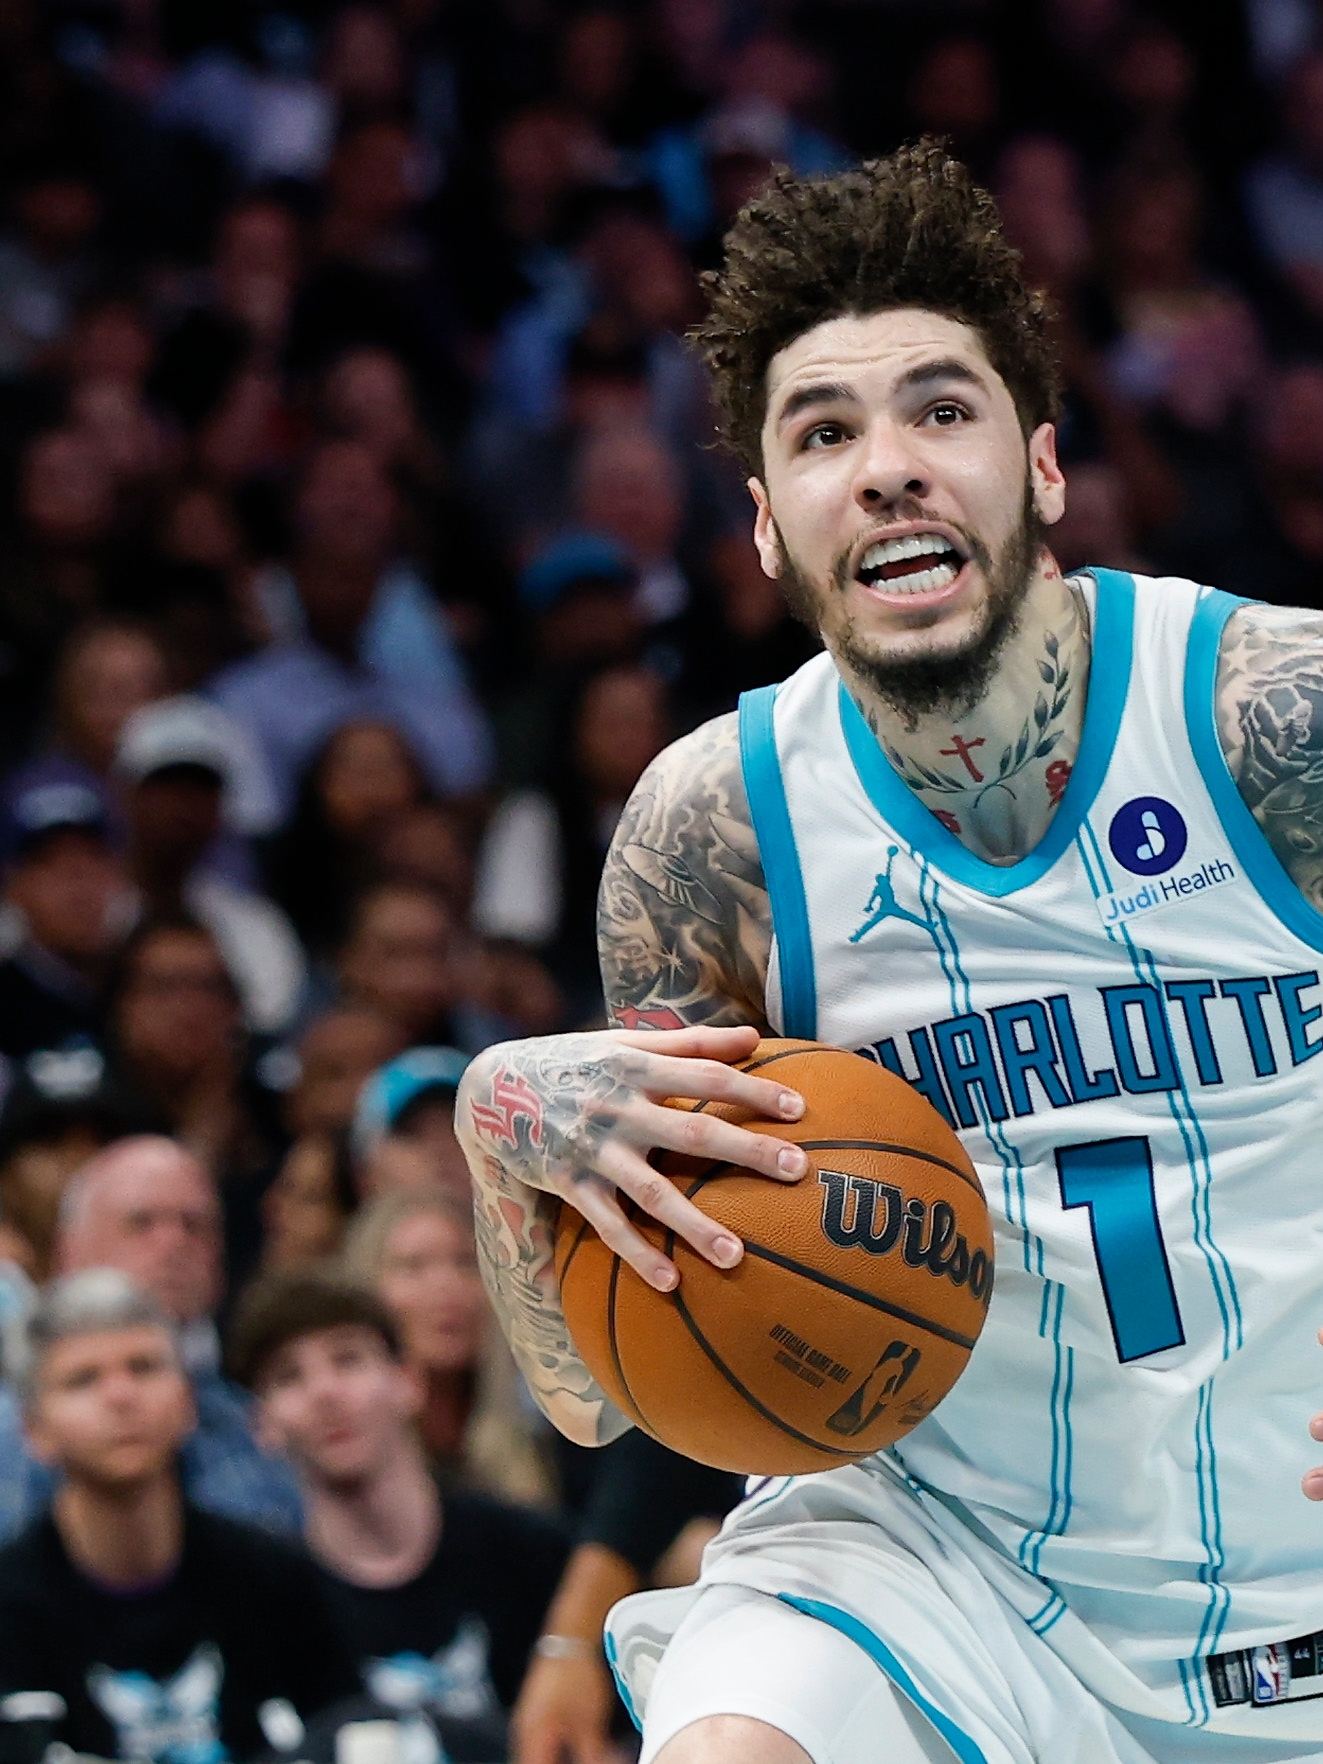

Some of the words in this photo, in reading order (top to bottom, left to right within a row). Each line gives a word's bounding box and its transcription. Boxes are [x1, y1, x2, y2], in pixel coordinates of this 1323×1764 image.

[1106, 884, 1160, 920] Judi
[1159, 859, 1235, 901] Health
[1054, 1135, 1186, 1364] 1
